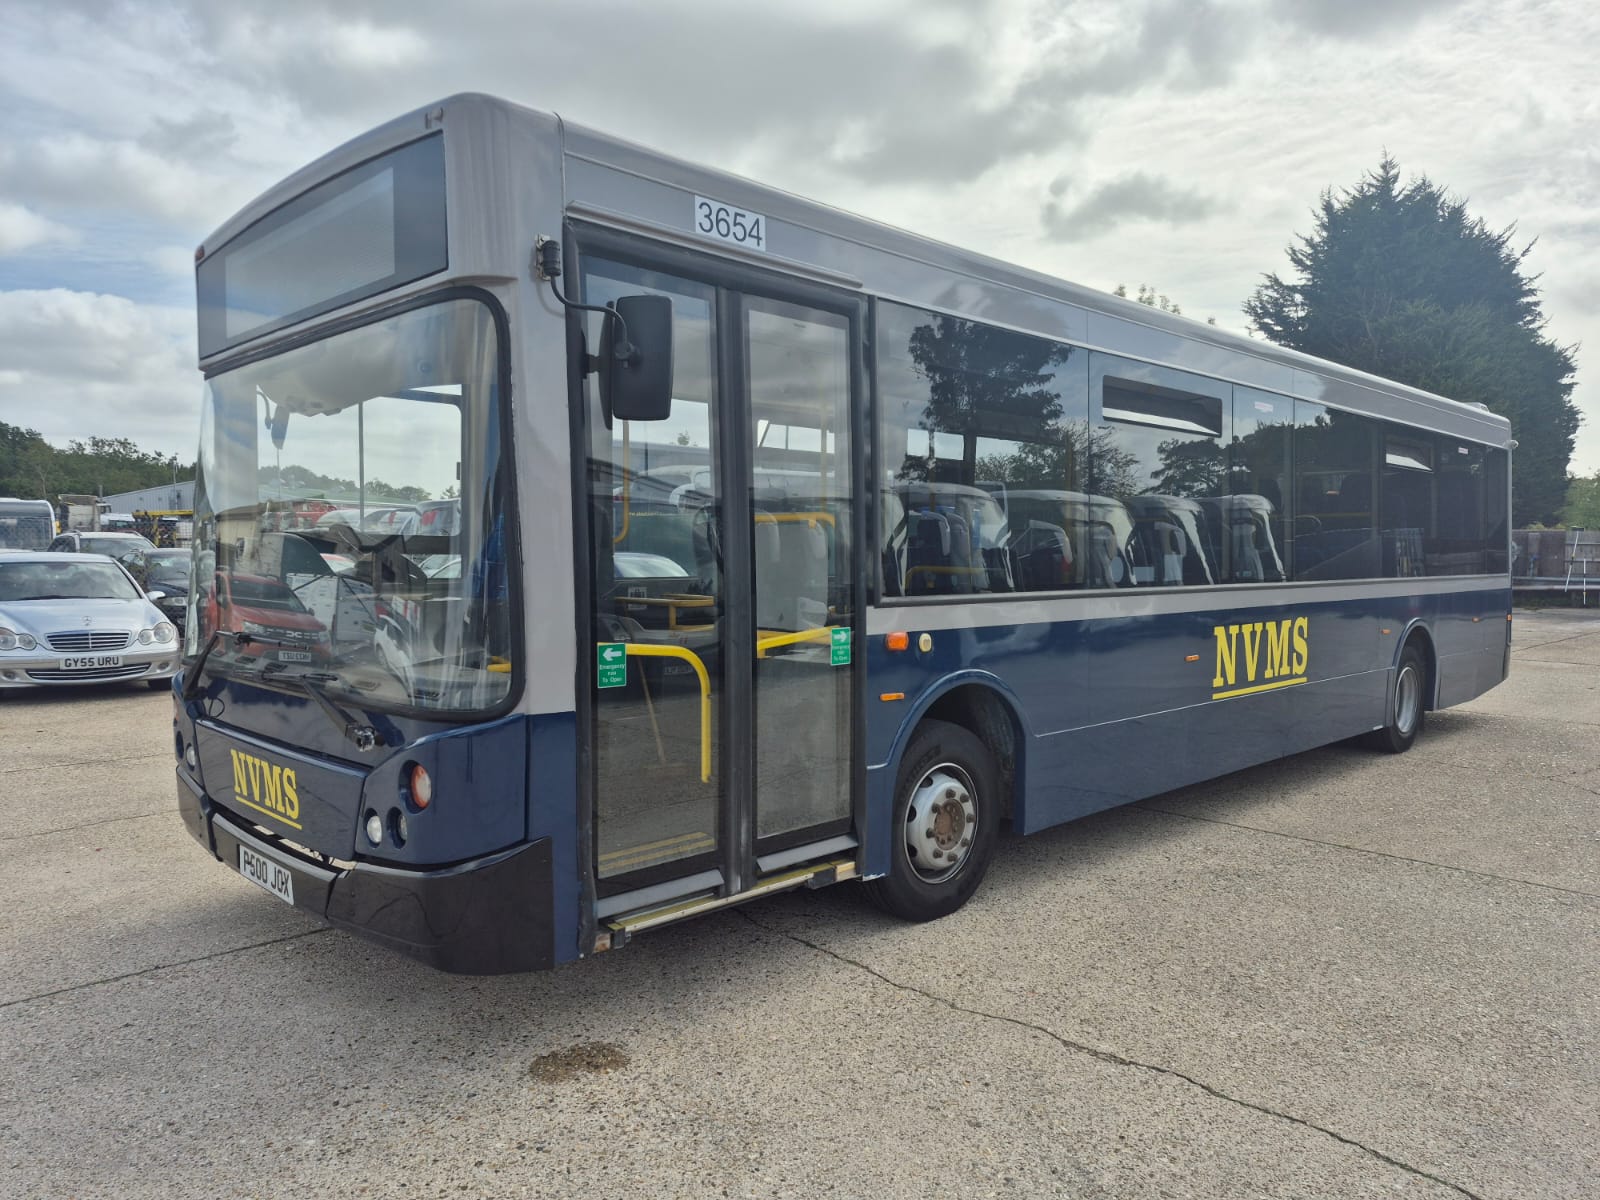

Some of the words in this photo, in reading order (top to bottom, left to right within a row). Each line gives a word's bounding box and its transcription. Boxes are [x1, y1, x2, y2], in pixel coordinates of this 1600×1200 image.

[698, 201, 763, 247] 3654
[64, 657, 96, 668] GY55
[97, 655, 119, 666] URU
[1212, 616, 1308, 688] NVMS
[230, 748, 299, 819] NVMS
[243, 850, 268, 884] P500
